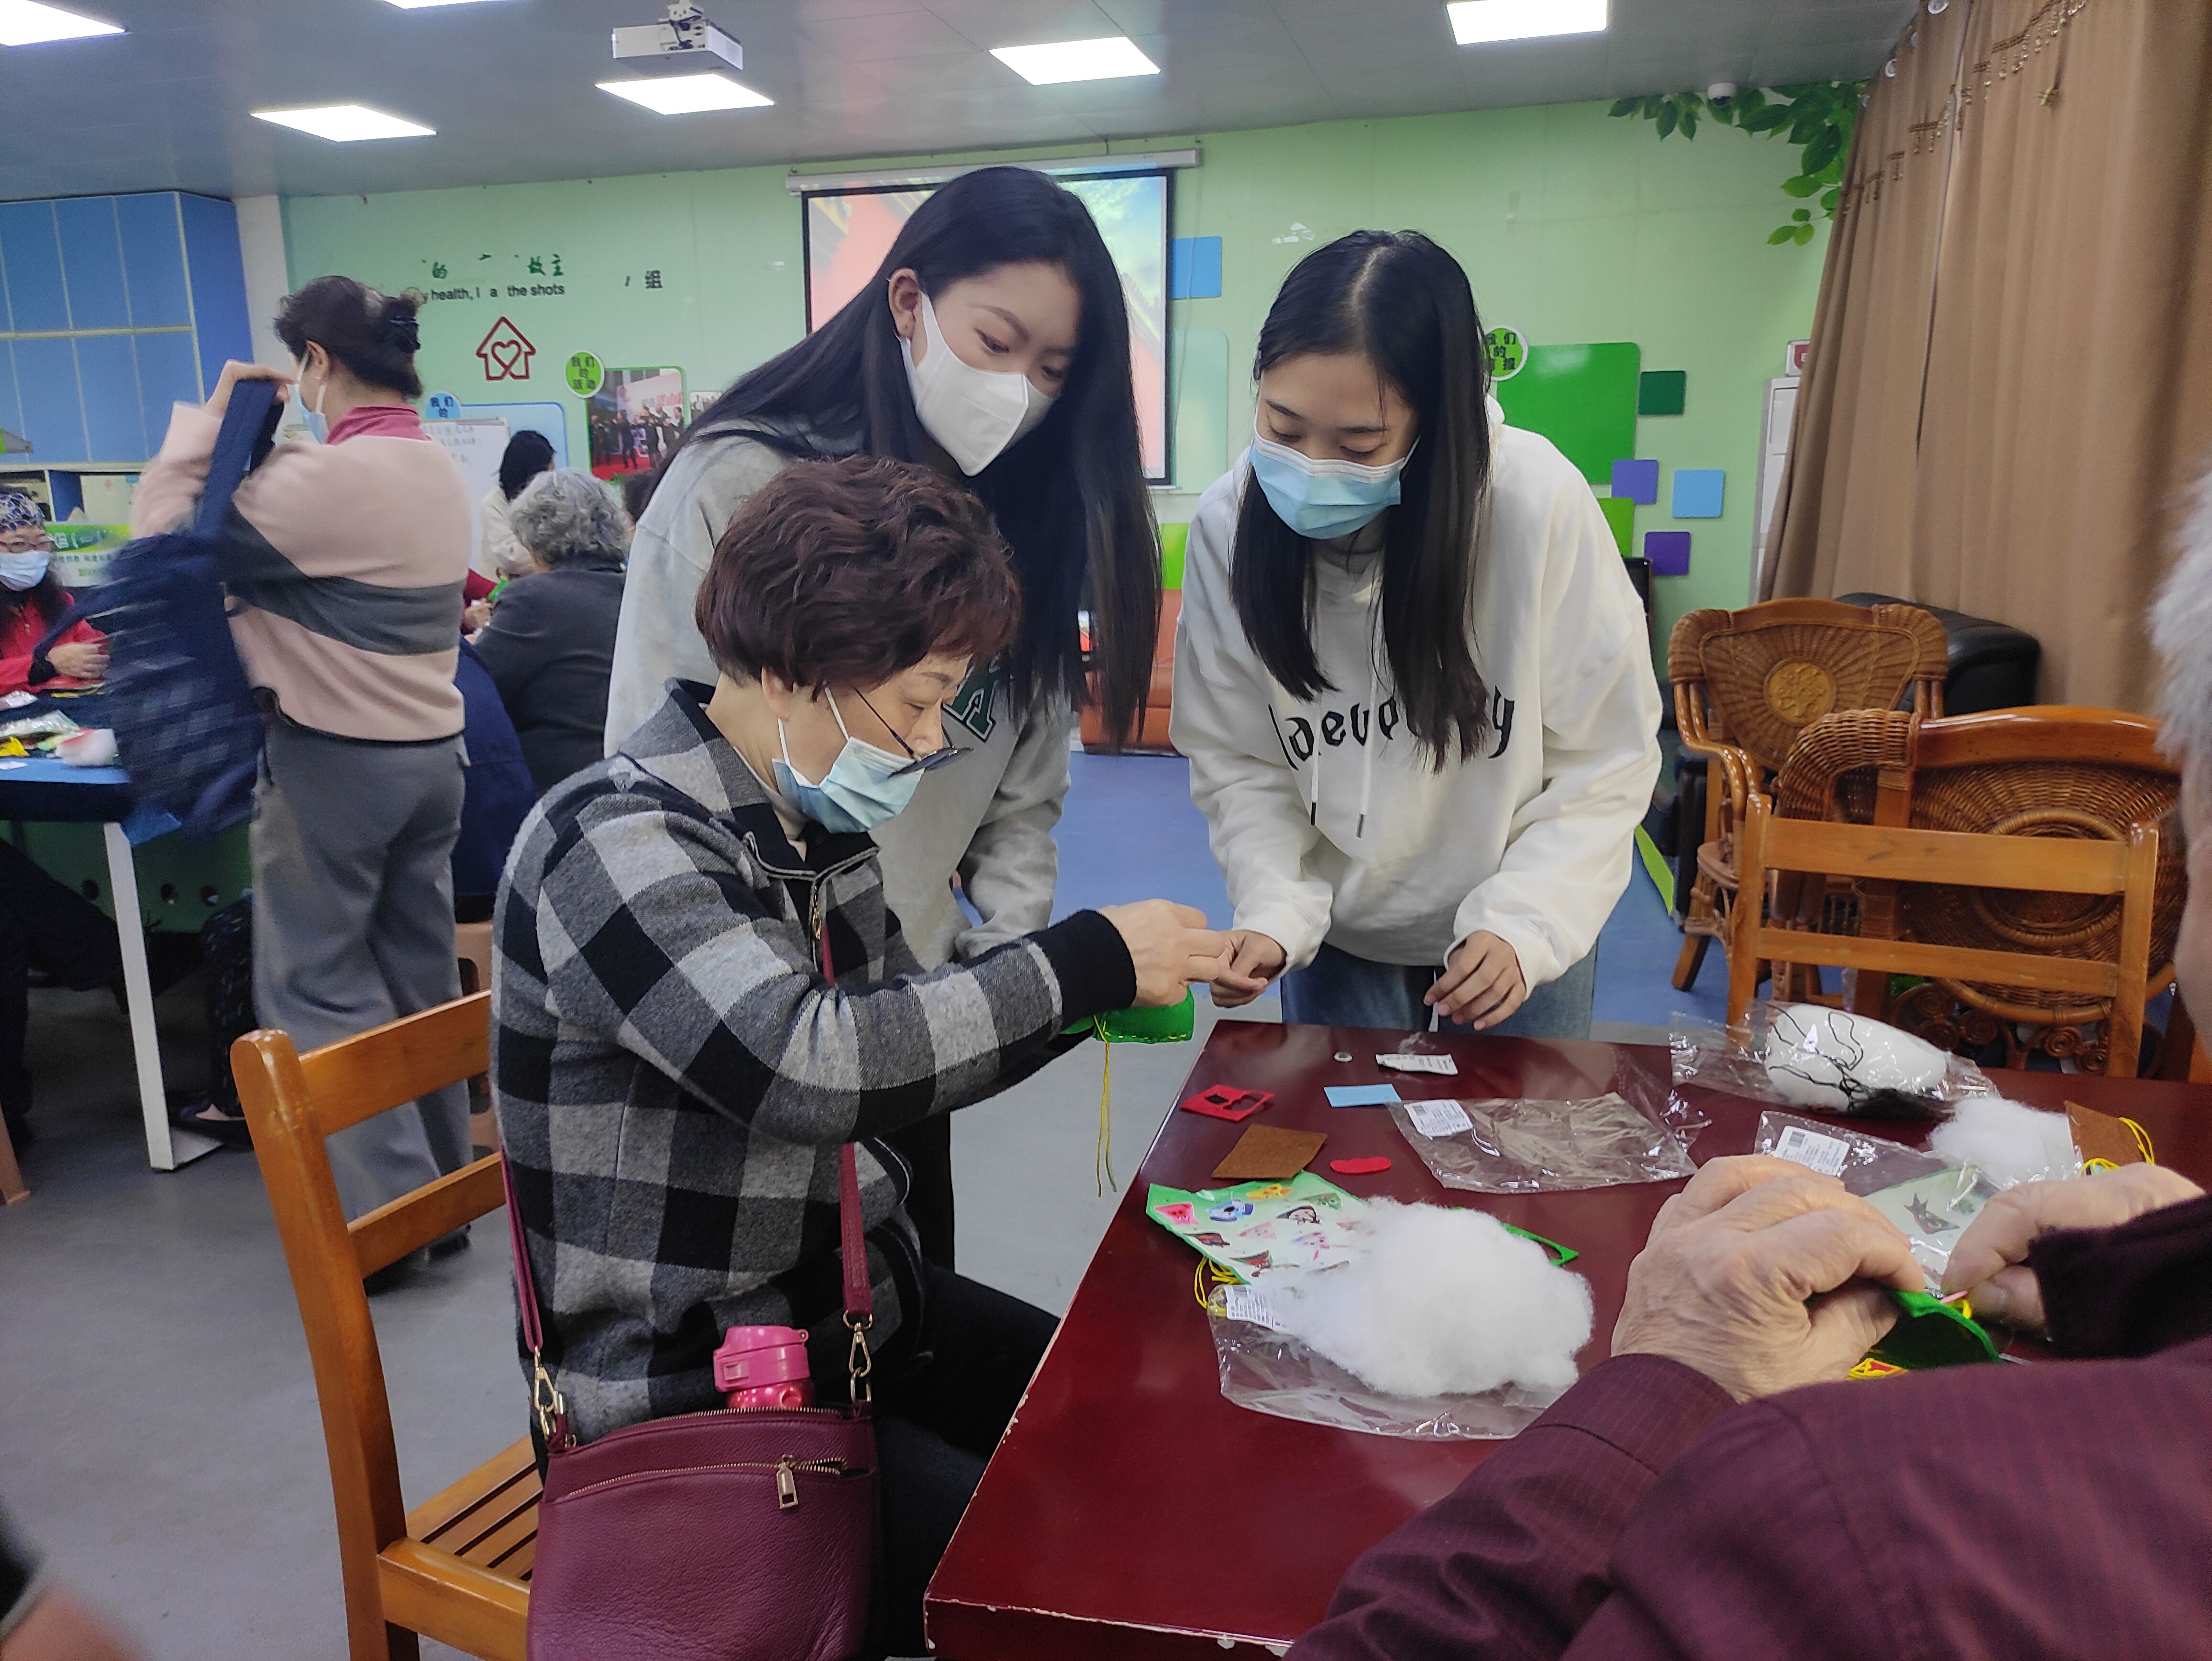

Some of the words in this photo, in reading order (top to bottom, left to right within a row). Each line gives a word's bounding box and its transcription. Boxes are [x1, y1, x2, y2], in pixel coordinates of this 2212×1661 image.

[431, 288, 474, 305] health,
[507, 285, 527, 298] the
[531, 284, 565, 297] shots
